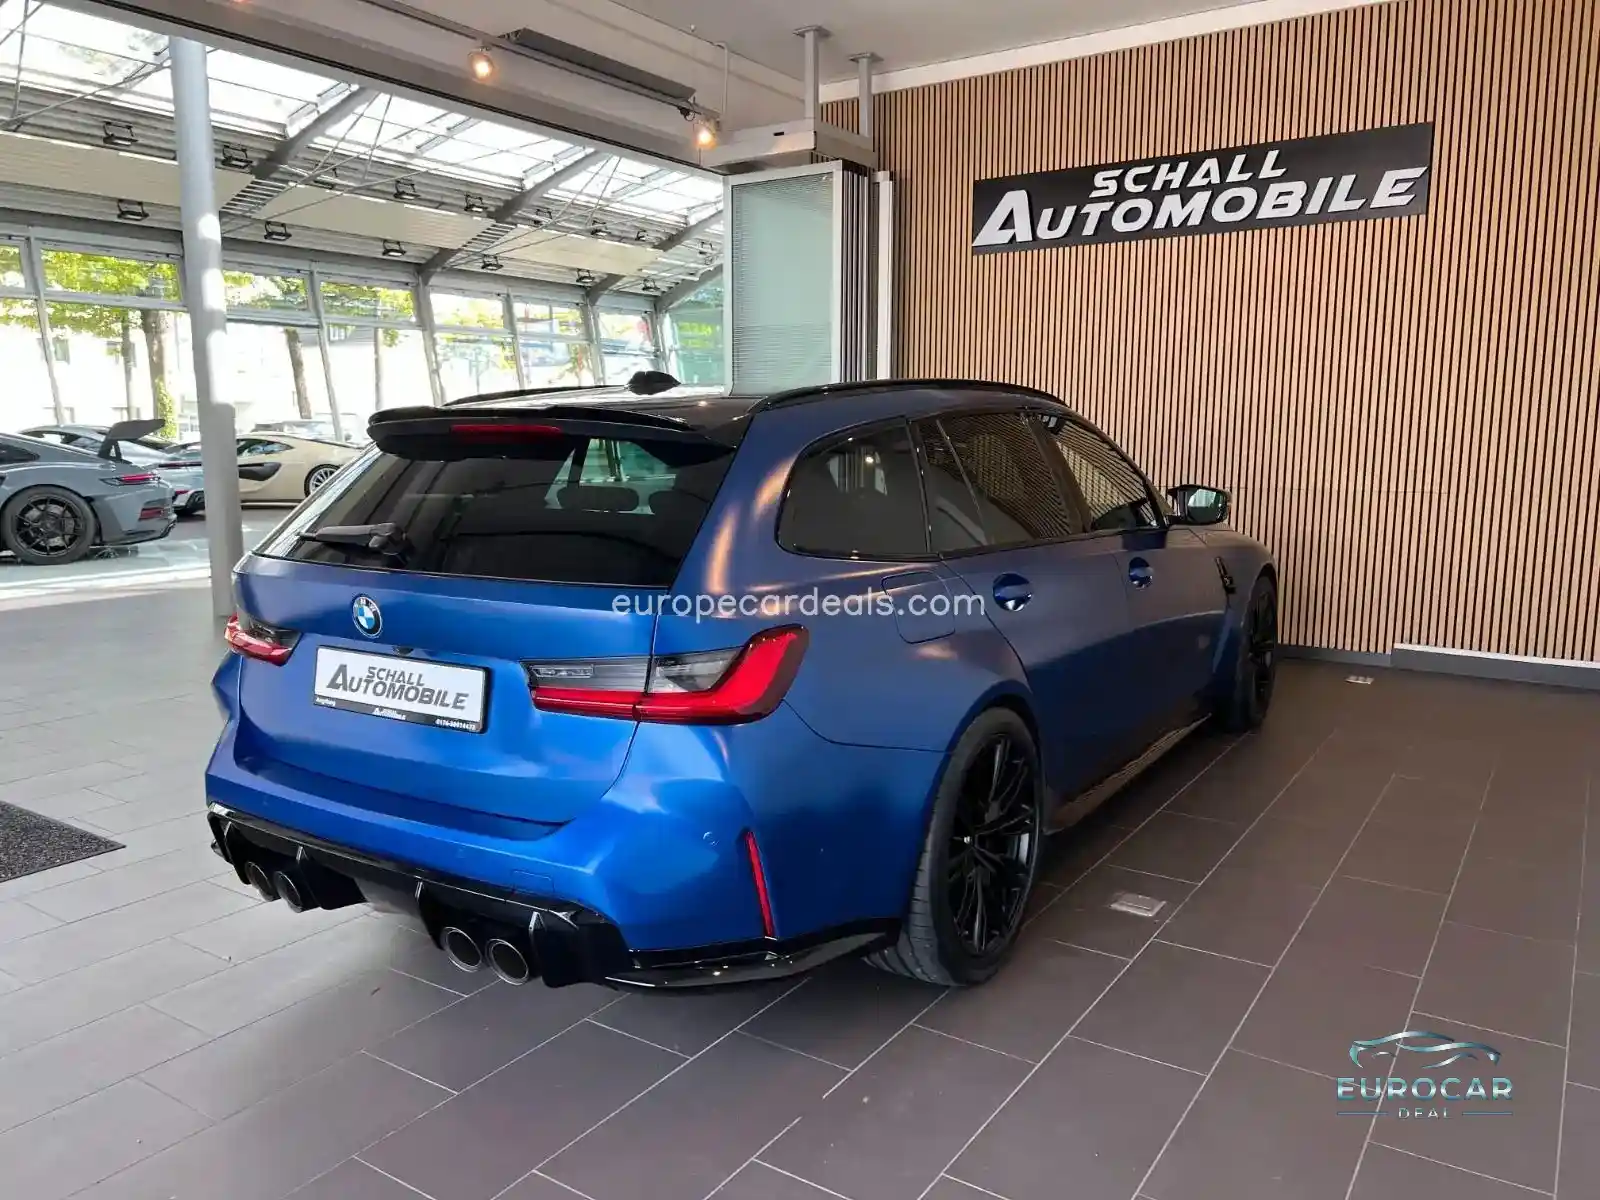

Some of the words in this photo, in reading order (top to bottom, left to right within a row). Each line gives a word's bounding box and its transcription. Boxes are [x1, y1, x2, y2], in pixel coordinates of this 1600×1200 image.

[1089, 149, 1287, 198] SCHALL
[972, 166, 1428, 247] AUTOMOBILE
[326, 664, 470, 710] AUTOMOBILE
[366, 666, 425, 687] SCHALL
